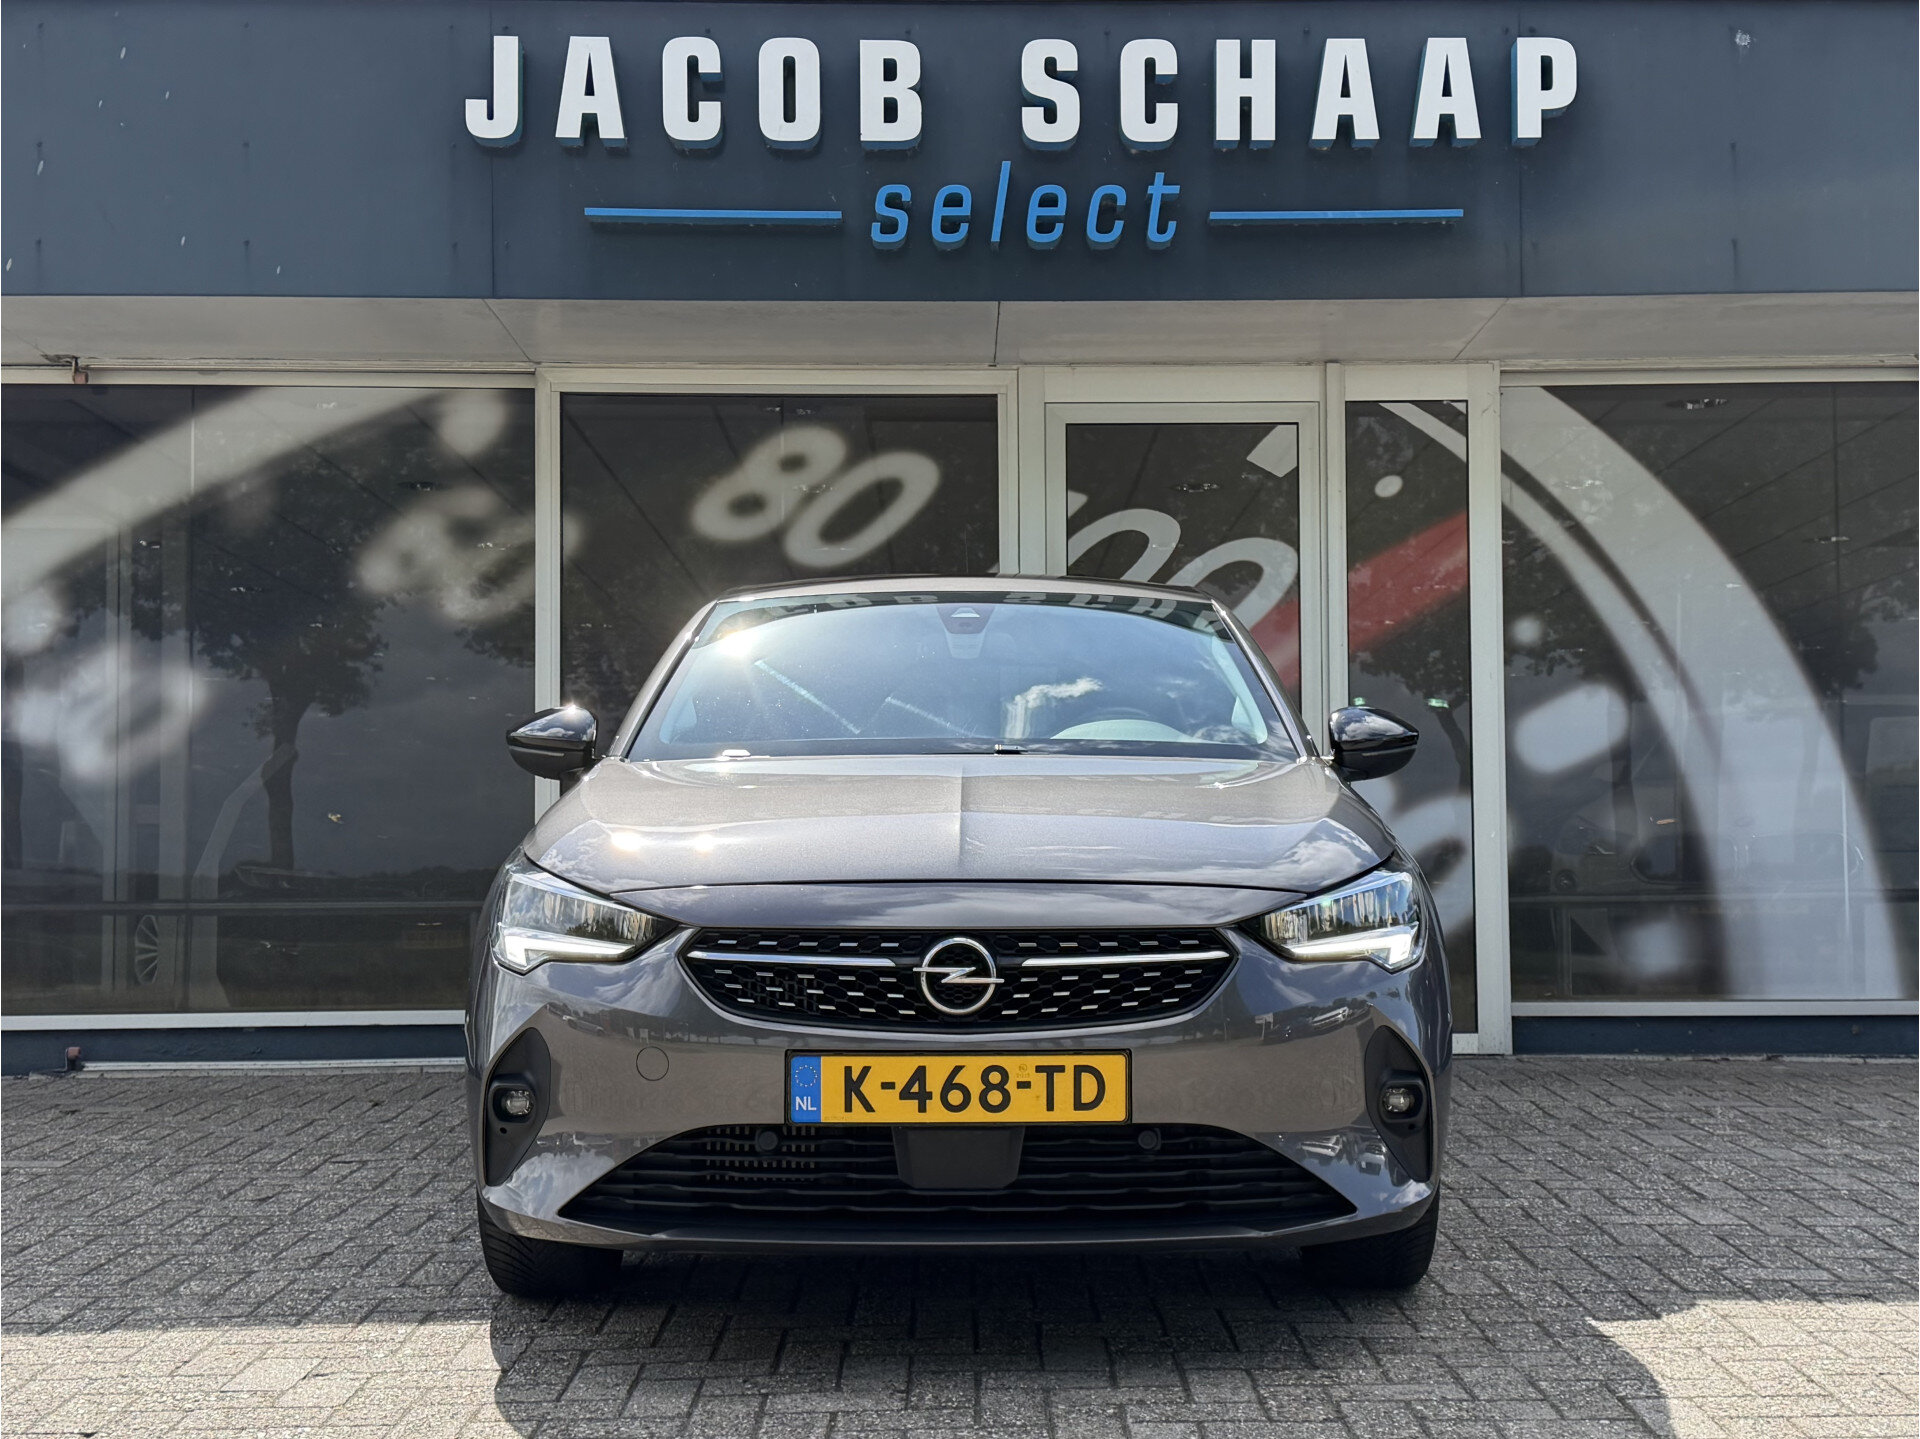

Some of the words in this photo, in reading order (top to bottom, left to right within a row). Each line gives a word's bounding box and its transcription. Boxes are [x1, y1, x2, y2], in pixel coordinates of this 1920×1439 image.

[465, 35, 923, 143] JACOB
[1020, 37, 1578, 143] SCHAAP
[870, 160, 1181, 244] select
[690, 424, 942, 569] 80
[795, 1095, 817, 1111] NL
[843, 1064, 1107, 1114] K-468-TD
